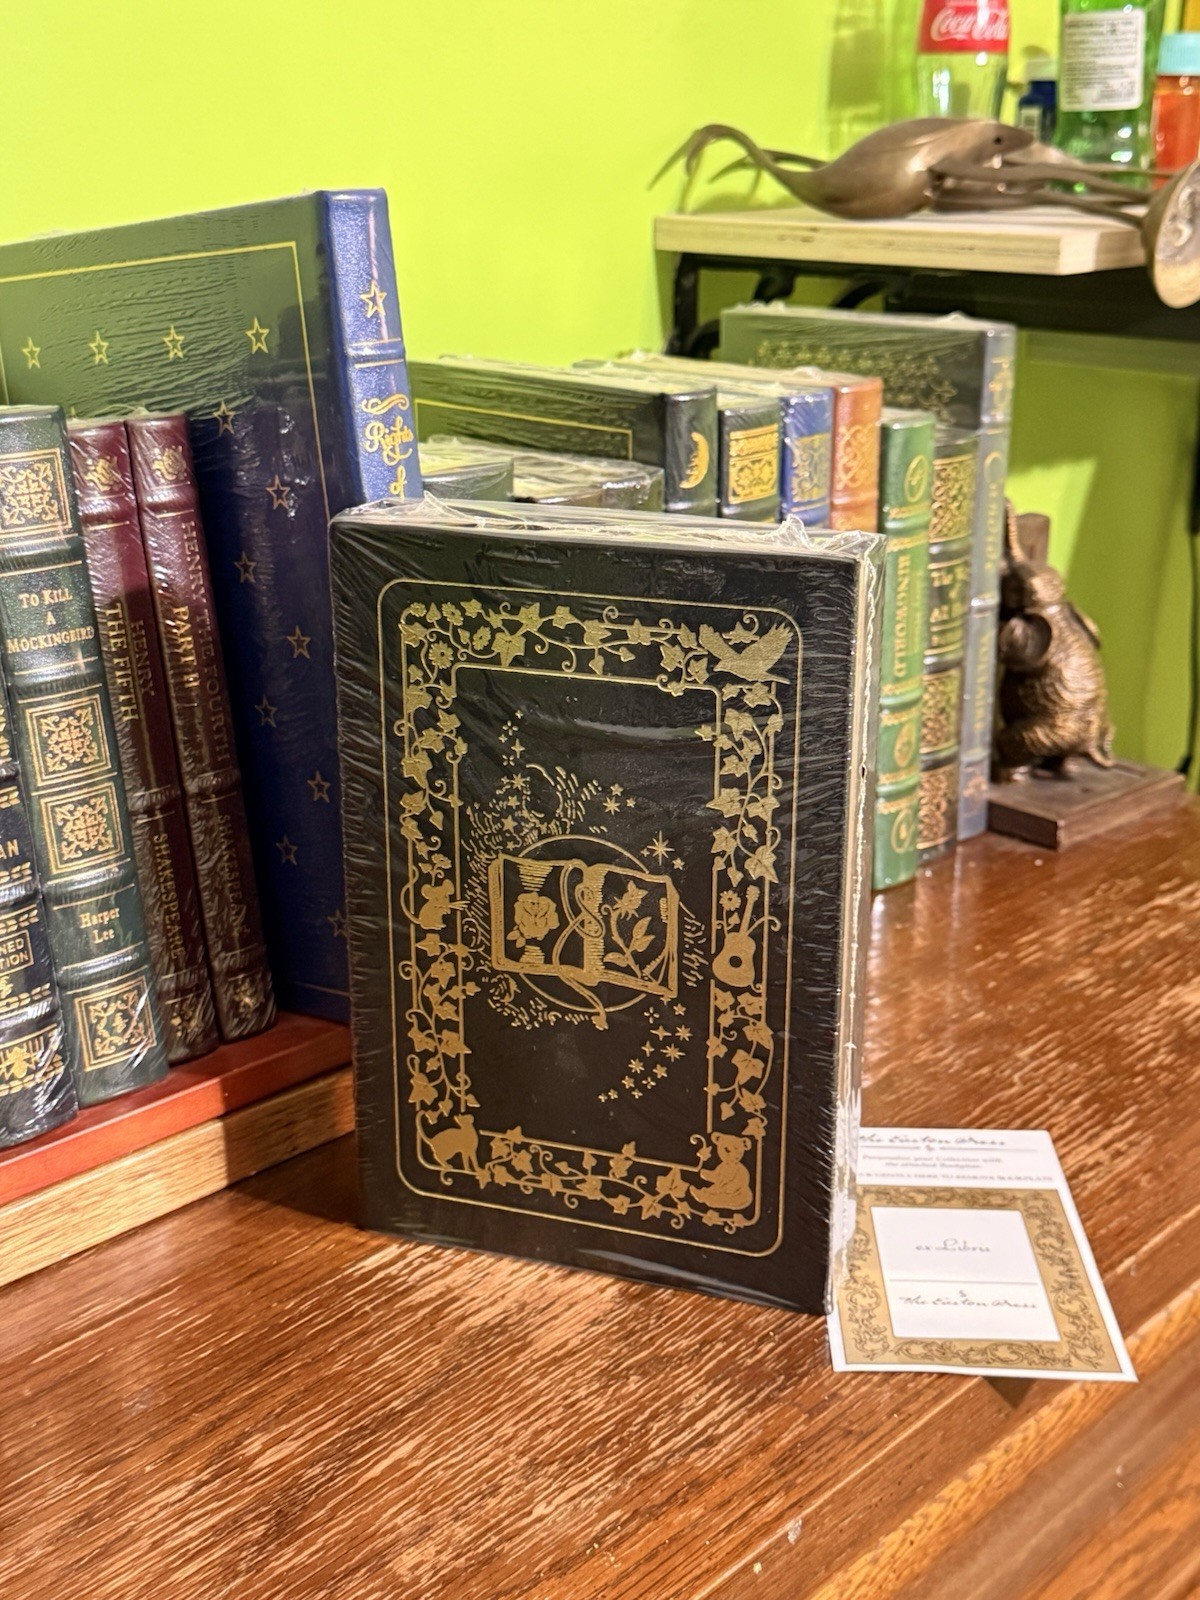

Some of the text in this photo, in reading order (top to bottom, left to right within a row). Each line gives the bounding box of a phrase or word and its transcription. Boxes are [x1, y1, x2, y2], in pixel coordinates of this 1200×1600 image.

[364, 416, 414, 466] Rights
[18, 588, 73, 609] TO KILL
[45, 611, 57, 626] A
[7, 626, 95, 654] MOCKINGBIRD
[130, 620, 155, 697] HENRY
[172, 606, 197, 667] PART
[182, 520, 231, 761] HENRY THE FOURTH
[105, 602, 139, 722] THE FIFTH
[79, 908, 120, 929] Harper
[154, 833, 186, 959] SHAKESPEARE
[92, 929, 115, 944] Lee
